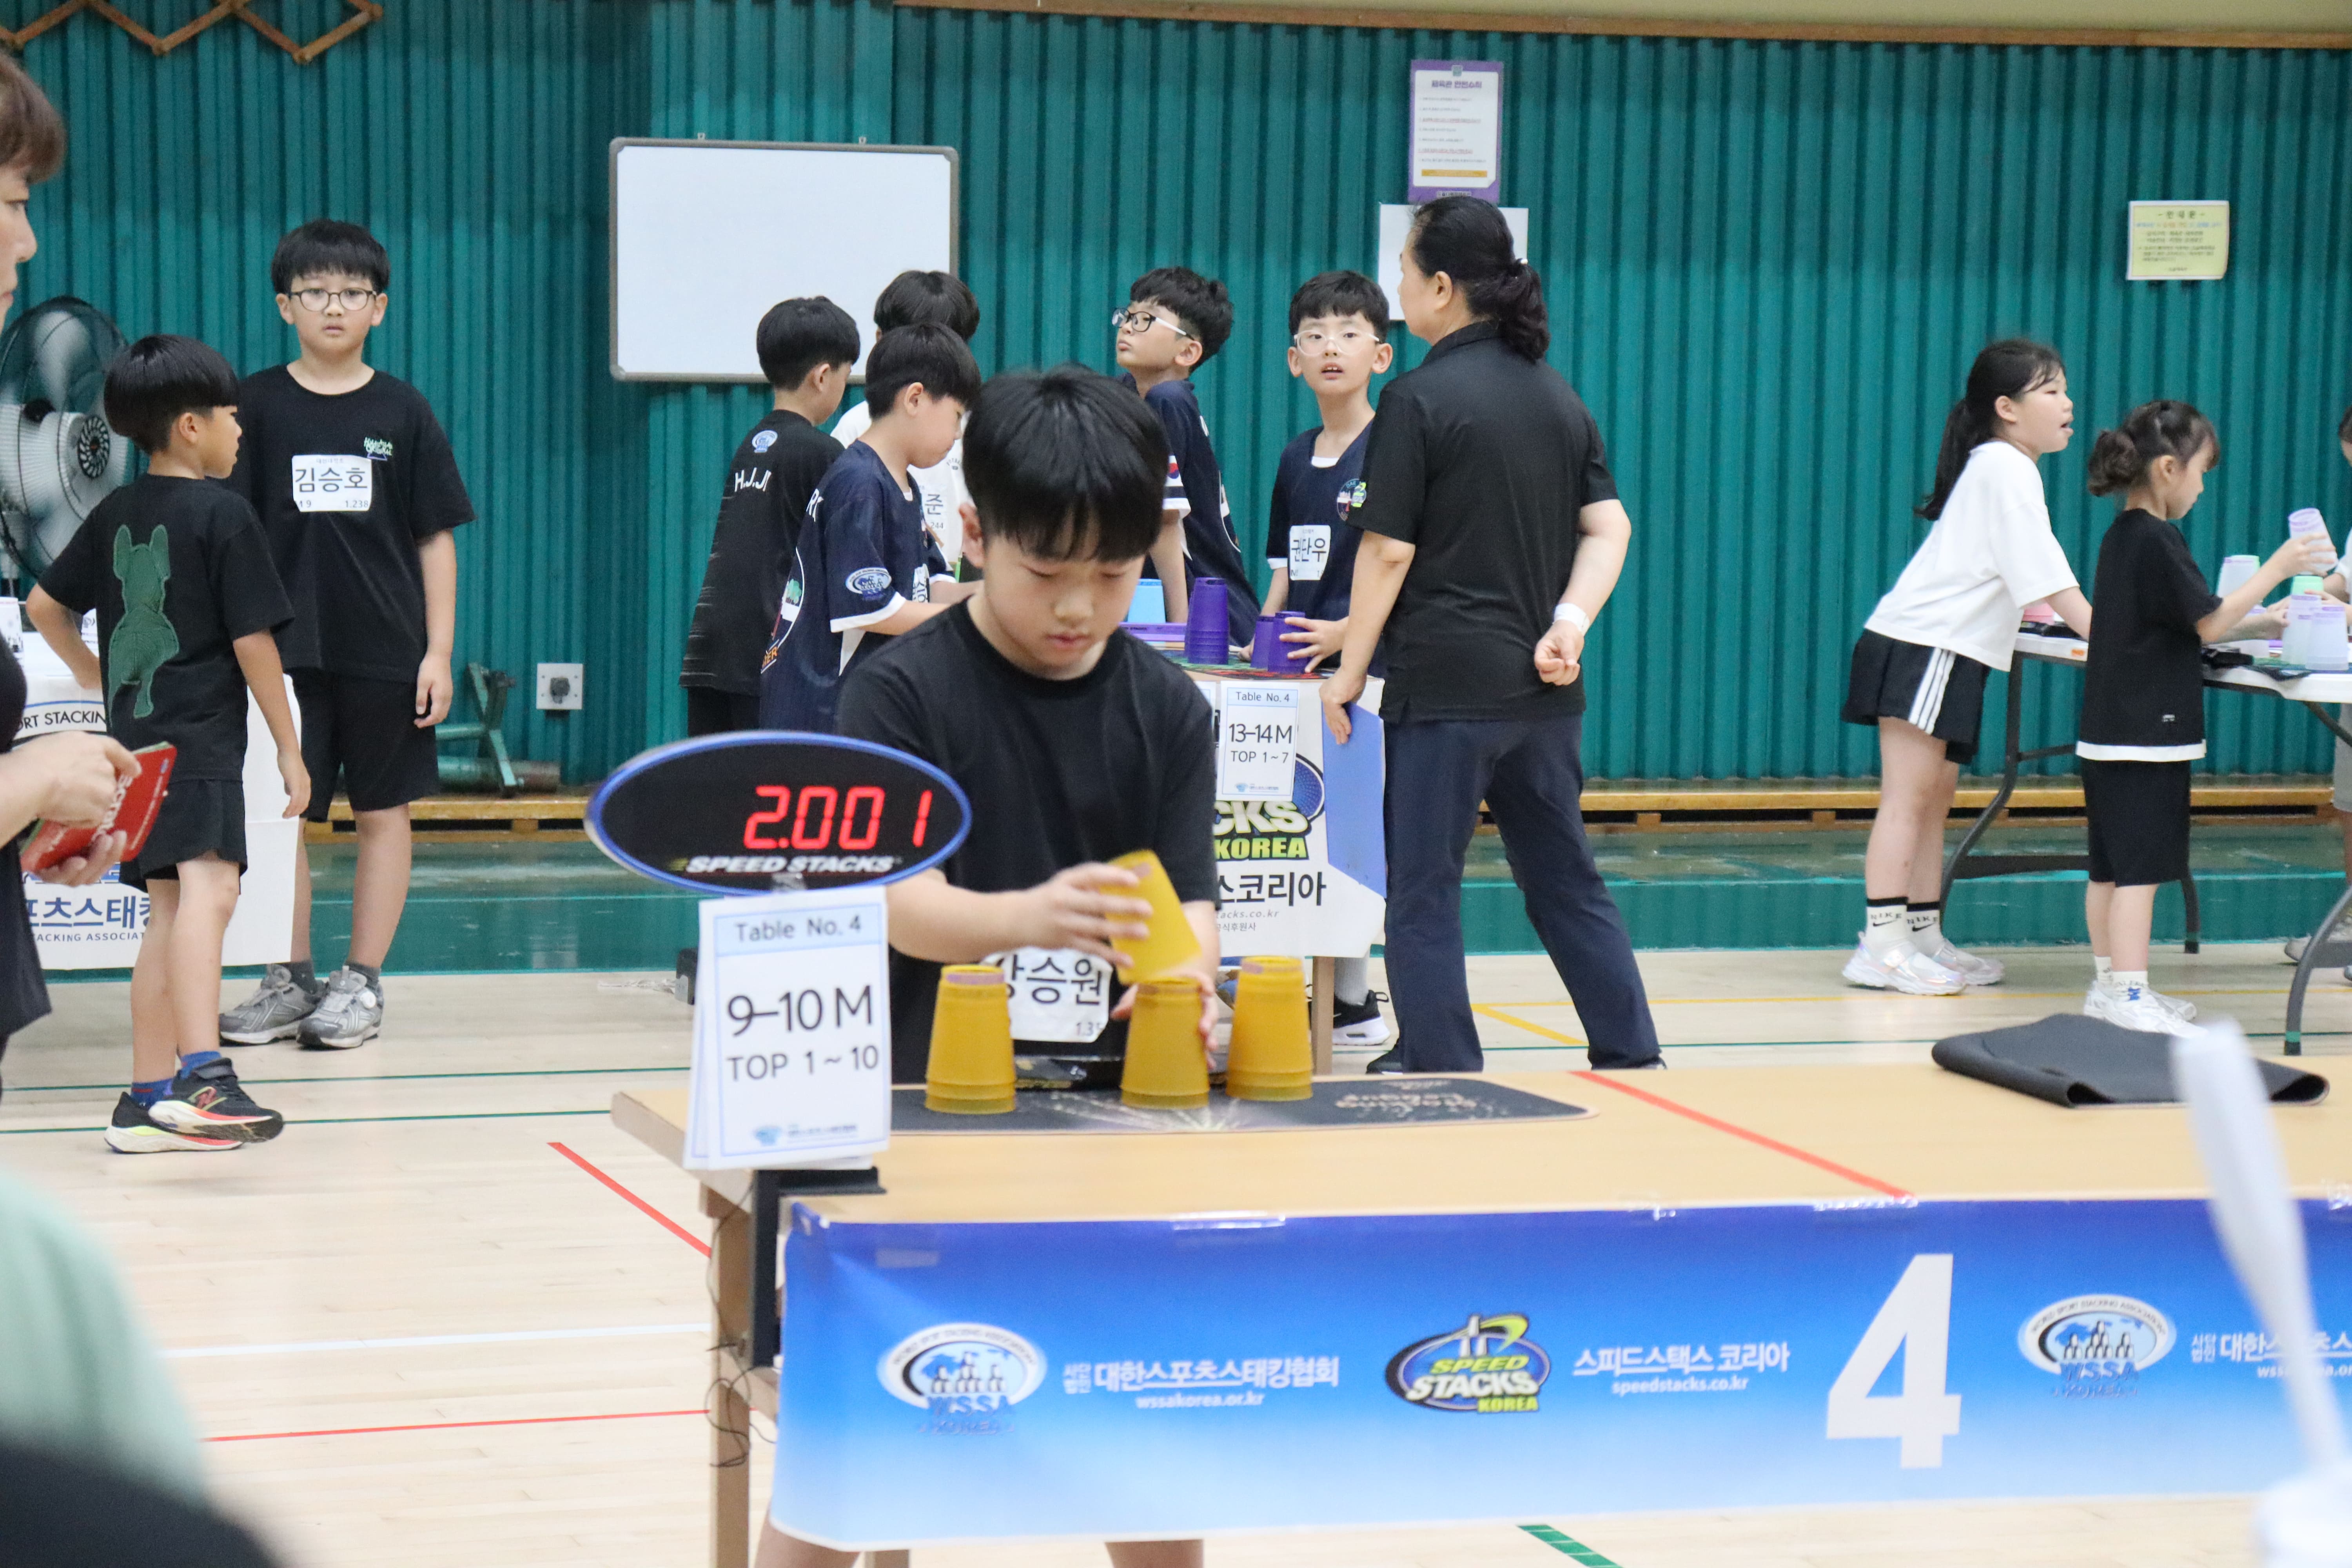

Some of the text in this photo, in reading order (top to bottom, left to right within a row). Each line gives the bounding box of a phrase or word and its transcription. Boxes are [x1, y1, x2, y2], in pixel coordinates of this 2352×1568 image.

[296, 467, 368, 492] 김승호
[1236, 691, 1290, 702] Table No. 4
[1230, 750, 1256, 762] TOP
[743, 786, 933, 850] 2.001
[1215, 837, 1307, 859] KOREA
[685, 855, 894, 873] SPEED STACKS
[735, 915, 862, 942] Table No. 4
[1907, 916, 1939, 924] NIKE
[726, 1053, 788, 1082] TOP
[1431, 1354, 1530, 1374] SPEED
[1572, 1341, 1791, 1377] 스피드스택스 코리아
[1826, 1253, 1962, 1470] 4
[1094, 1356, 1339, 1392] 대한스포츠스태킹협회
[1406, 1370, 1540, 1401] STACKS
[1611, 1375, 1749, 1397] speedstacks.co.kr
[1135, 1391, 1265, 1409] wssakorea.or.kr
[1477, 1396, 1539, 1413] KOREA
